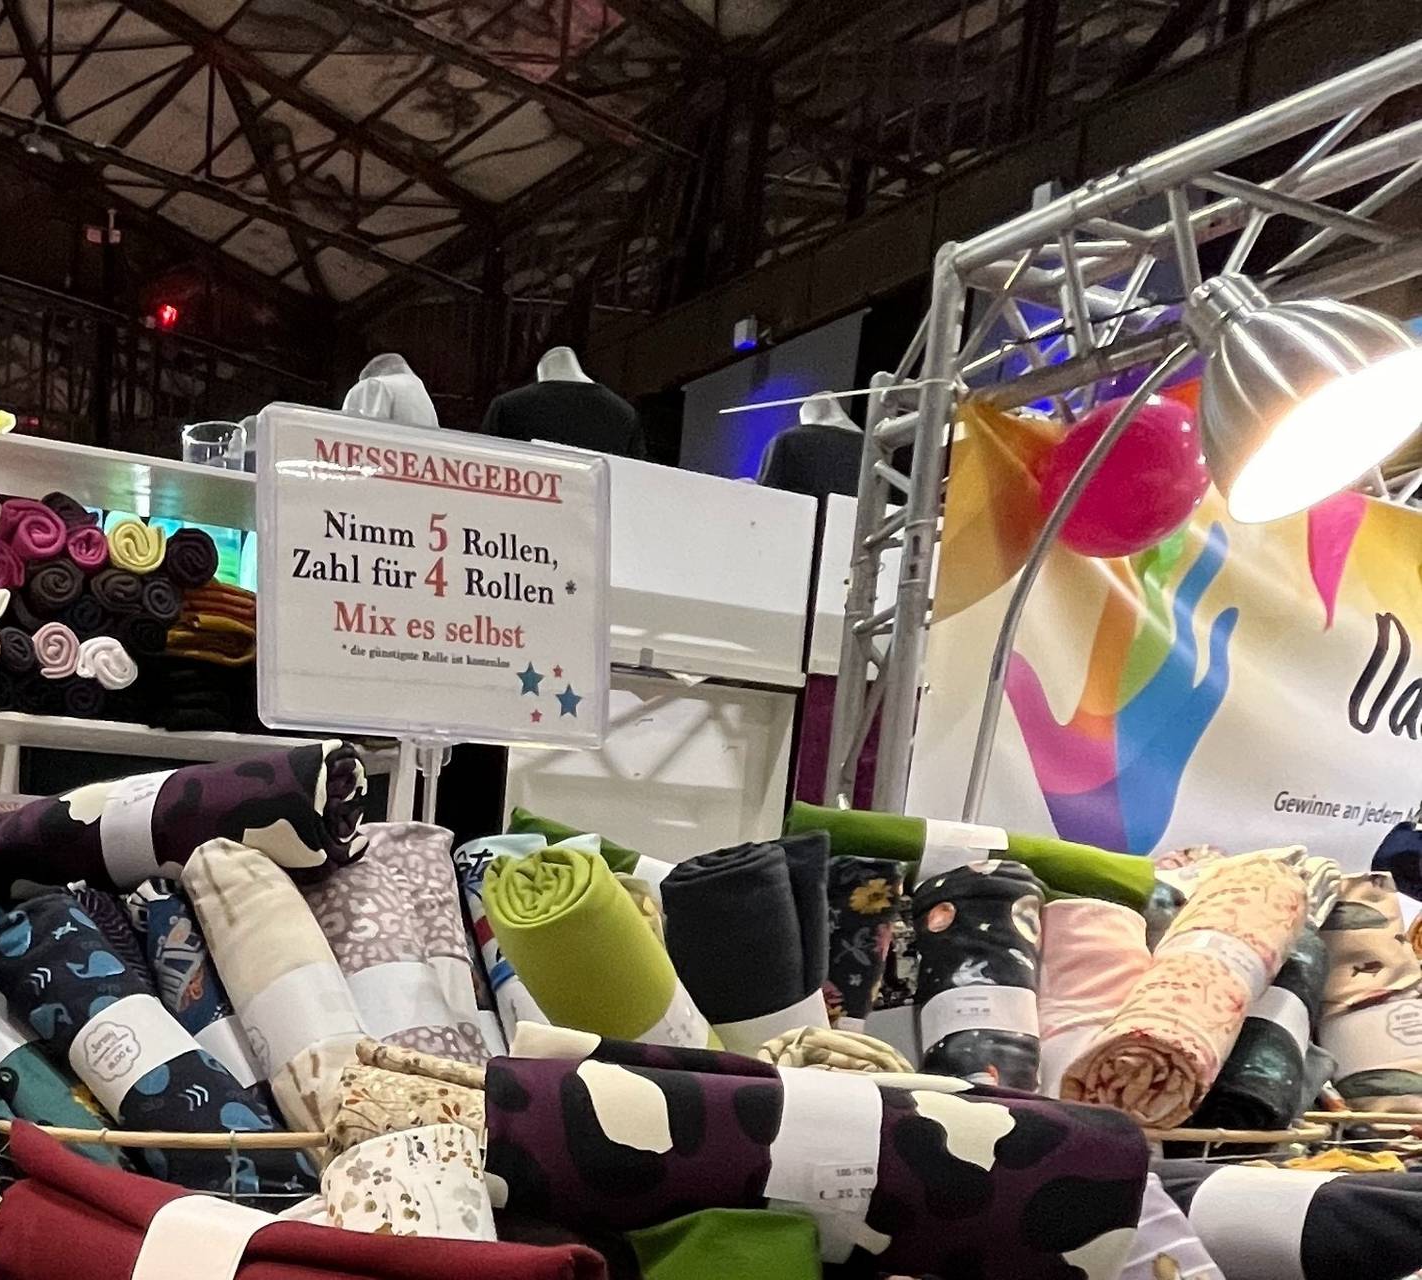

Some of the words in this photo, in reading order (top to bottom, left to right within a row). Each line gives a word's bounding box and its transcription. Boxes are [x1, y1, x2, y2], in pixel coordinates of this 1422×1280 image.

[314, 438, 563, 498] MESSEANGEBOT
[323, 509, 416, 548] Nimm
[428, 512, 448, 552] 5
[462, 528, 559, 570] Rollen,
[292, 549, 360, 583] Zahl
[371, 557, 417, 588] für
[424, 557, 448, 597] 4
[465, 567, 554, 604] Rollen
[333, 600, 397, 636] Mix
[406, 617, 436, 640] es
[445, 615, 525, 649] selbst
[350, 644, 366, 656] die
[369, 647, 419, 661] günstigste
[422, 651, 449, 664] Rolle
[451, 654, 463, 664] ist
[466, 654, 510, 668] kostenlos
[1348, 612, 1422, 740] Da
[1273, 791, 1341, 818] Gewinne
[1342, 803, 1360, 820] an
[1358, 801, 1403, 825] jedem
